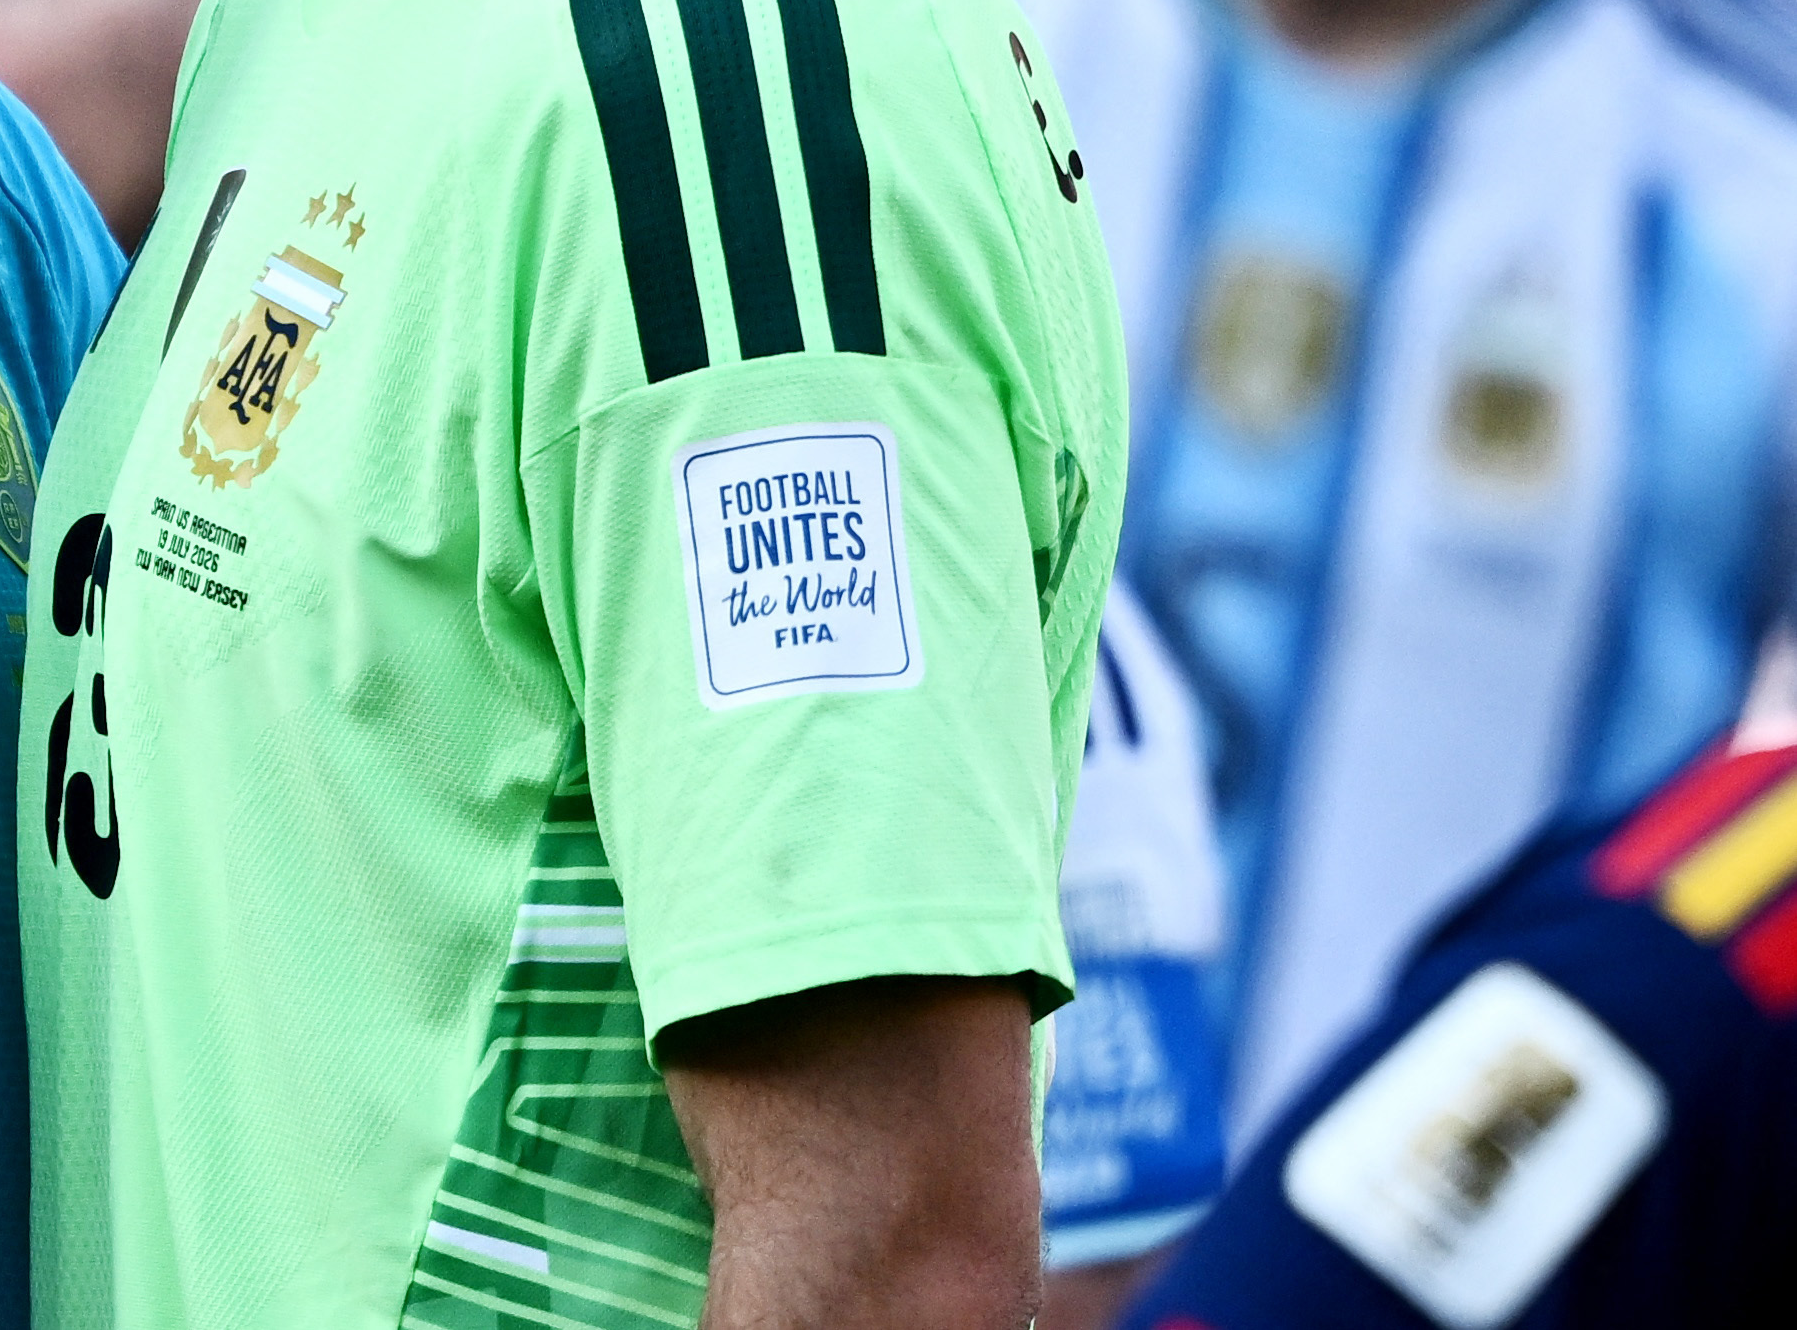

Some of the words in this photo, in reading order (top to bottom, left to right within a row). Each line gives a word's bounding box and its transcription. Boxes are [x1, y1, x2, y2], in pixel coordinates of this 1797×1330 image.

[217, 306, 299, 426] AFA
[718, 470, 862, 520] FOOTBALL
[157, 528, 168, 550] 19
[167, 533, 191, 559] JULY
[190, 544, 220, 573] 2026
[189, 514, 247, 557] ARGENTINA
[724, 511, 866, 574] UNITES
[152, 555, 177, 583] YORK
[176, 566, 201, 593] NEW
[200, 577, 249, 612] JERSEY
[722, 580, 777, 627] the
[783, 566, 877, 616] World
[774, 622, 836, 649] FIFA
